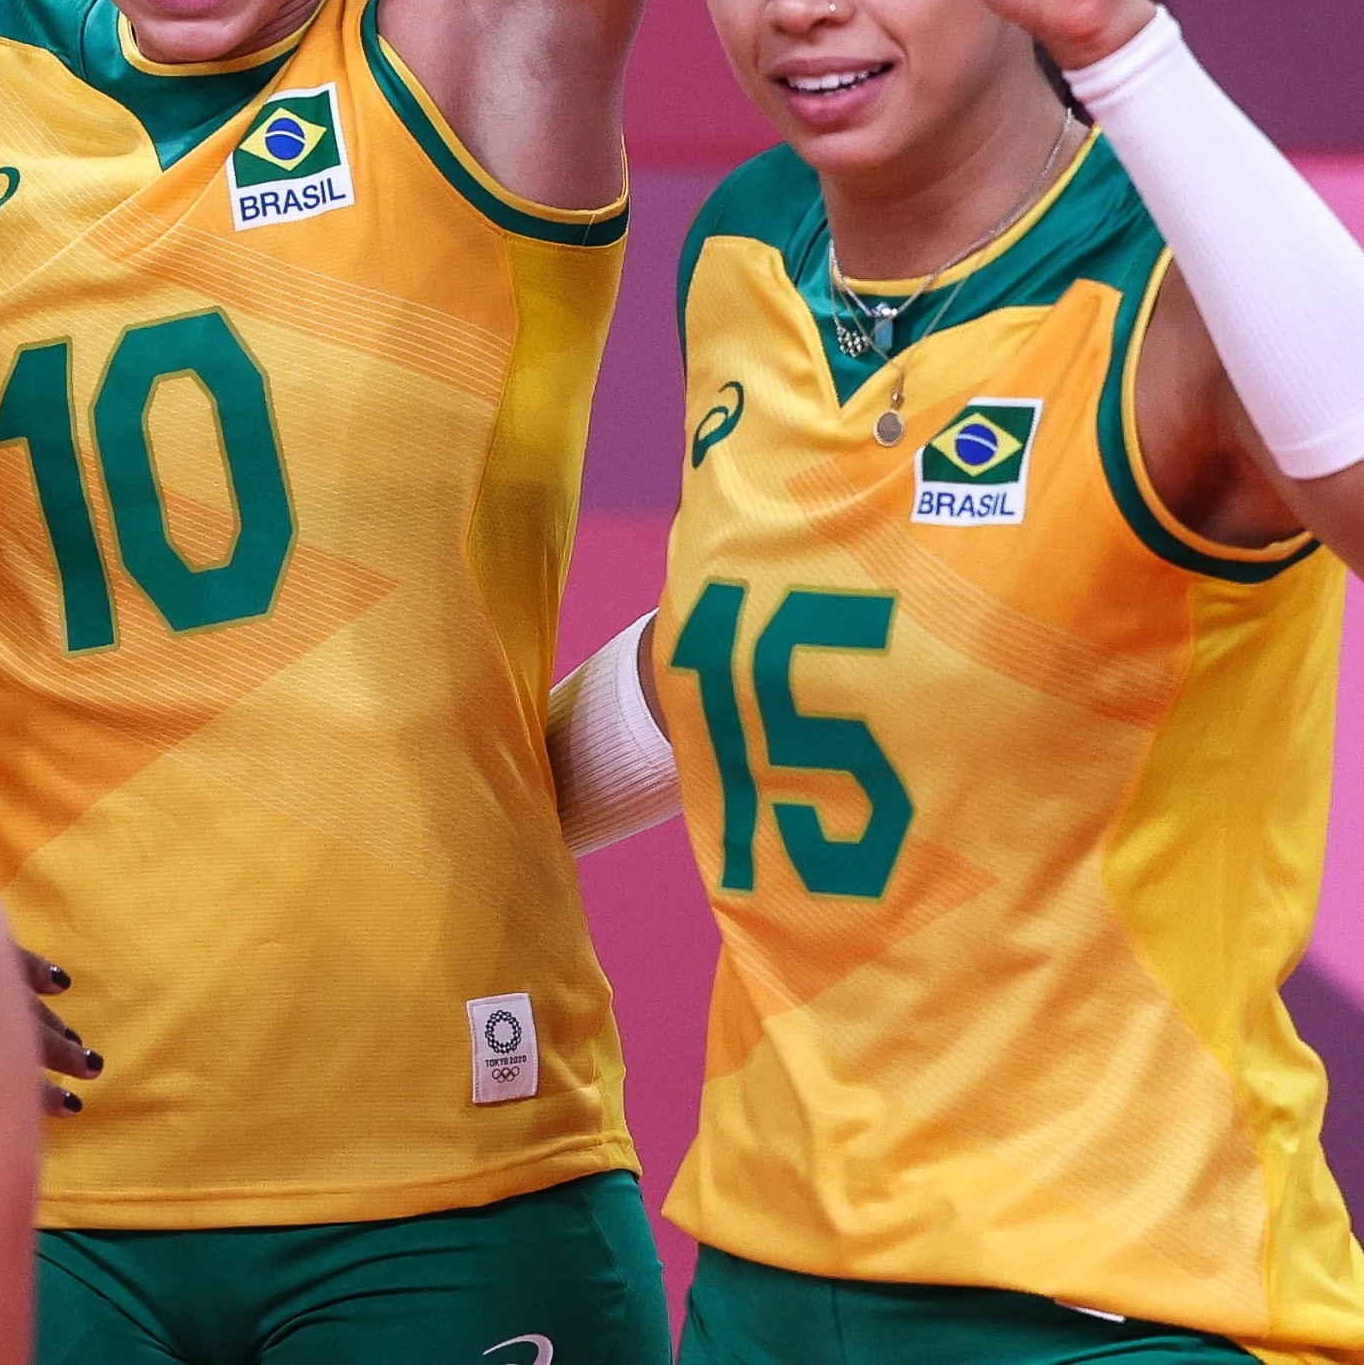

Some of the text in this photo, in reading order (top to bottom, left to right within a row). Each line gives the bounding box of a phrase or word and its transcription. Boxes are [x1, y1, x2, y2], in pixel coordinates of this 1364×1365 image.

[239, 178, 347, 222] BRASIL
[917, 491, 1016, 517] BRASIL
[669, 579, 916, 902] 15
[485, 1055, 527, 1067] TOKYO 2020
